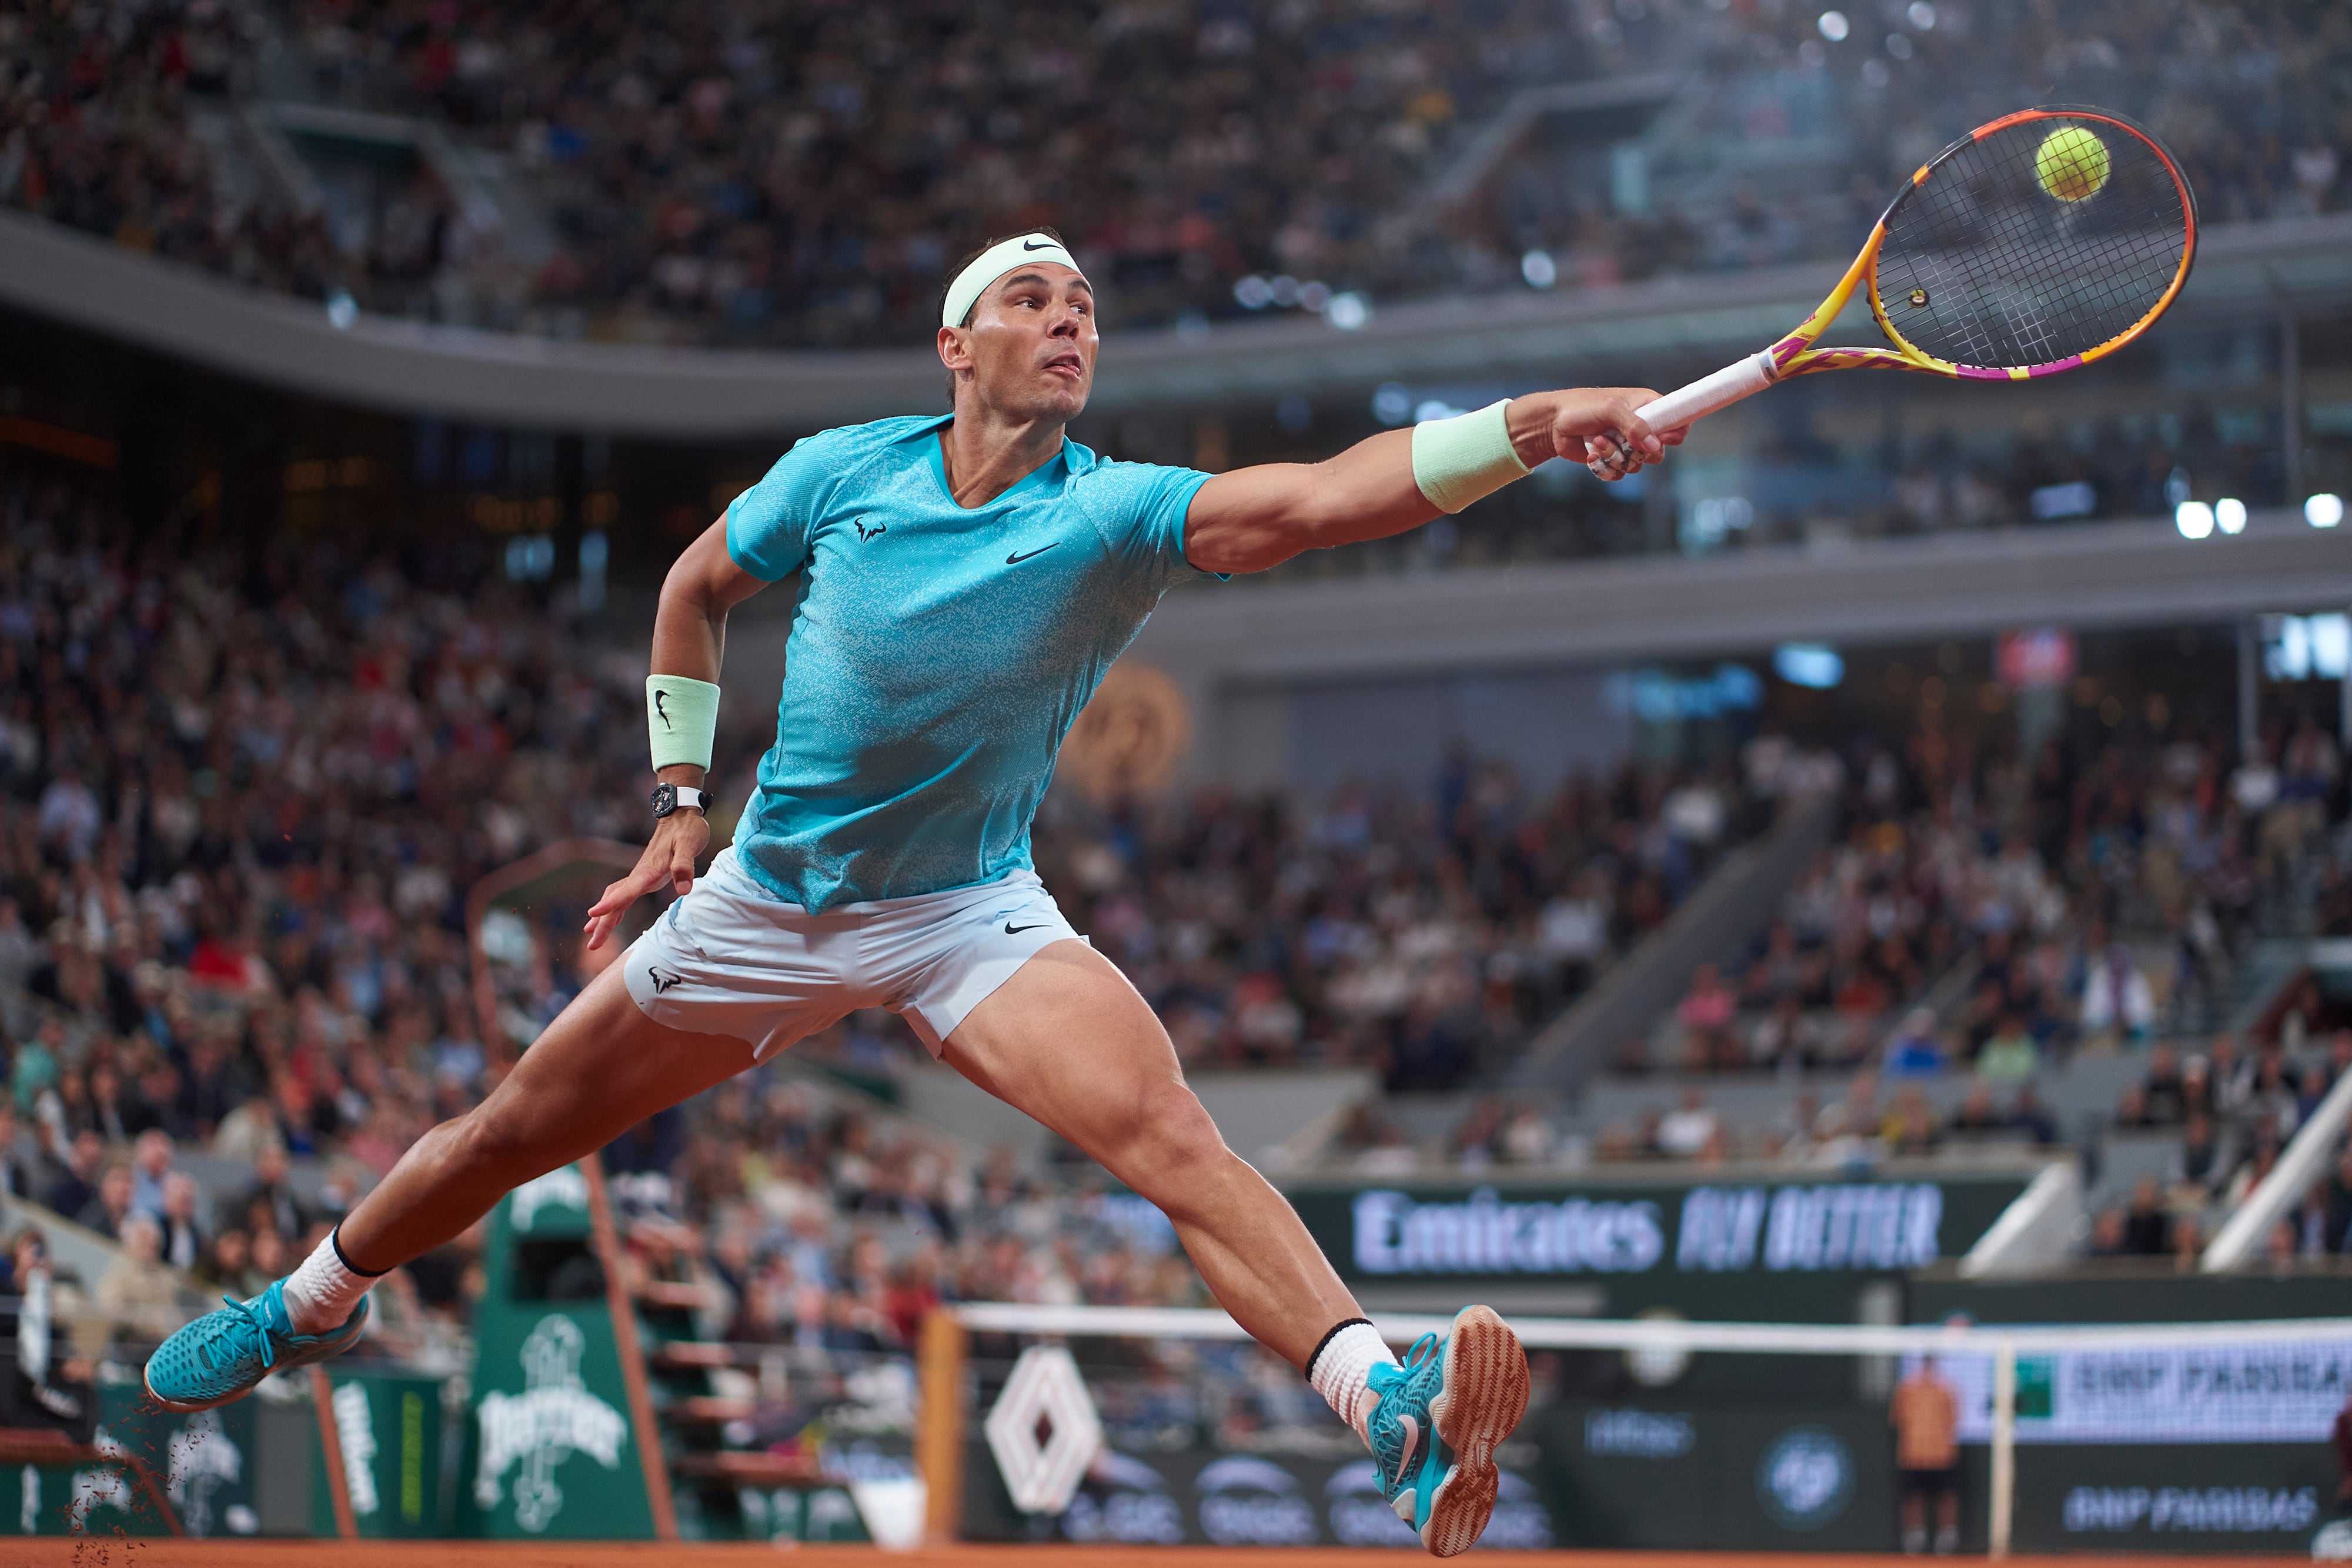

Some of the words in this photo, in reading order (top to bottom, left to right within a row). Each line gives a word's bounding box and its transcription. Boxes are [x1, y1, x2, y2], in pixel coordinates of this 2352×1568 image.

[1354, 1188, 1663, 1273] Emirates
[1678, 1185, 1763, 1271] FLY
[1765, 1184, 1942, 1270] BETTER
[2064, 1486, 2150, 1532] BNP
[2151, 1486, 2318, 1532] PARIBAS
